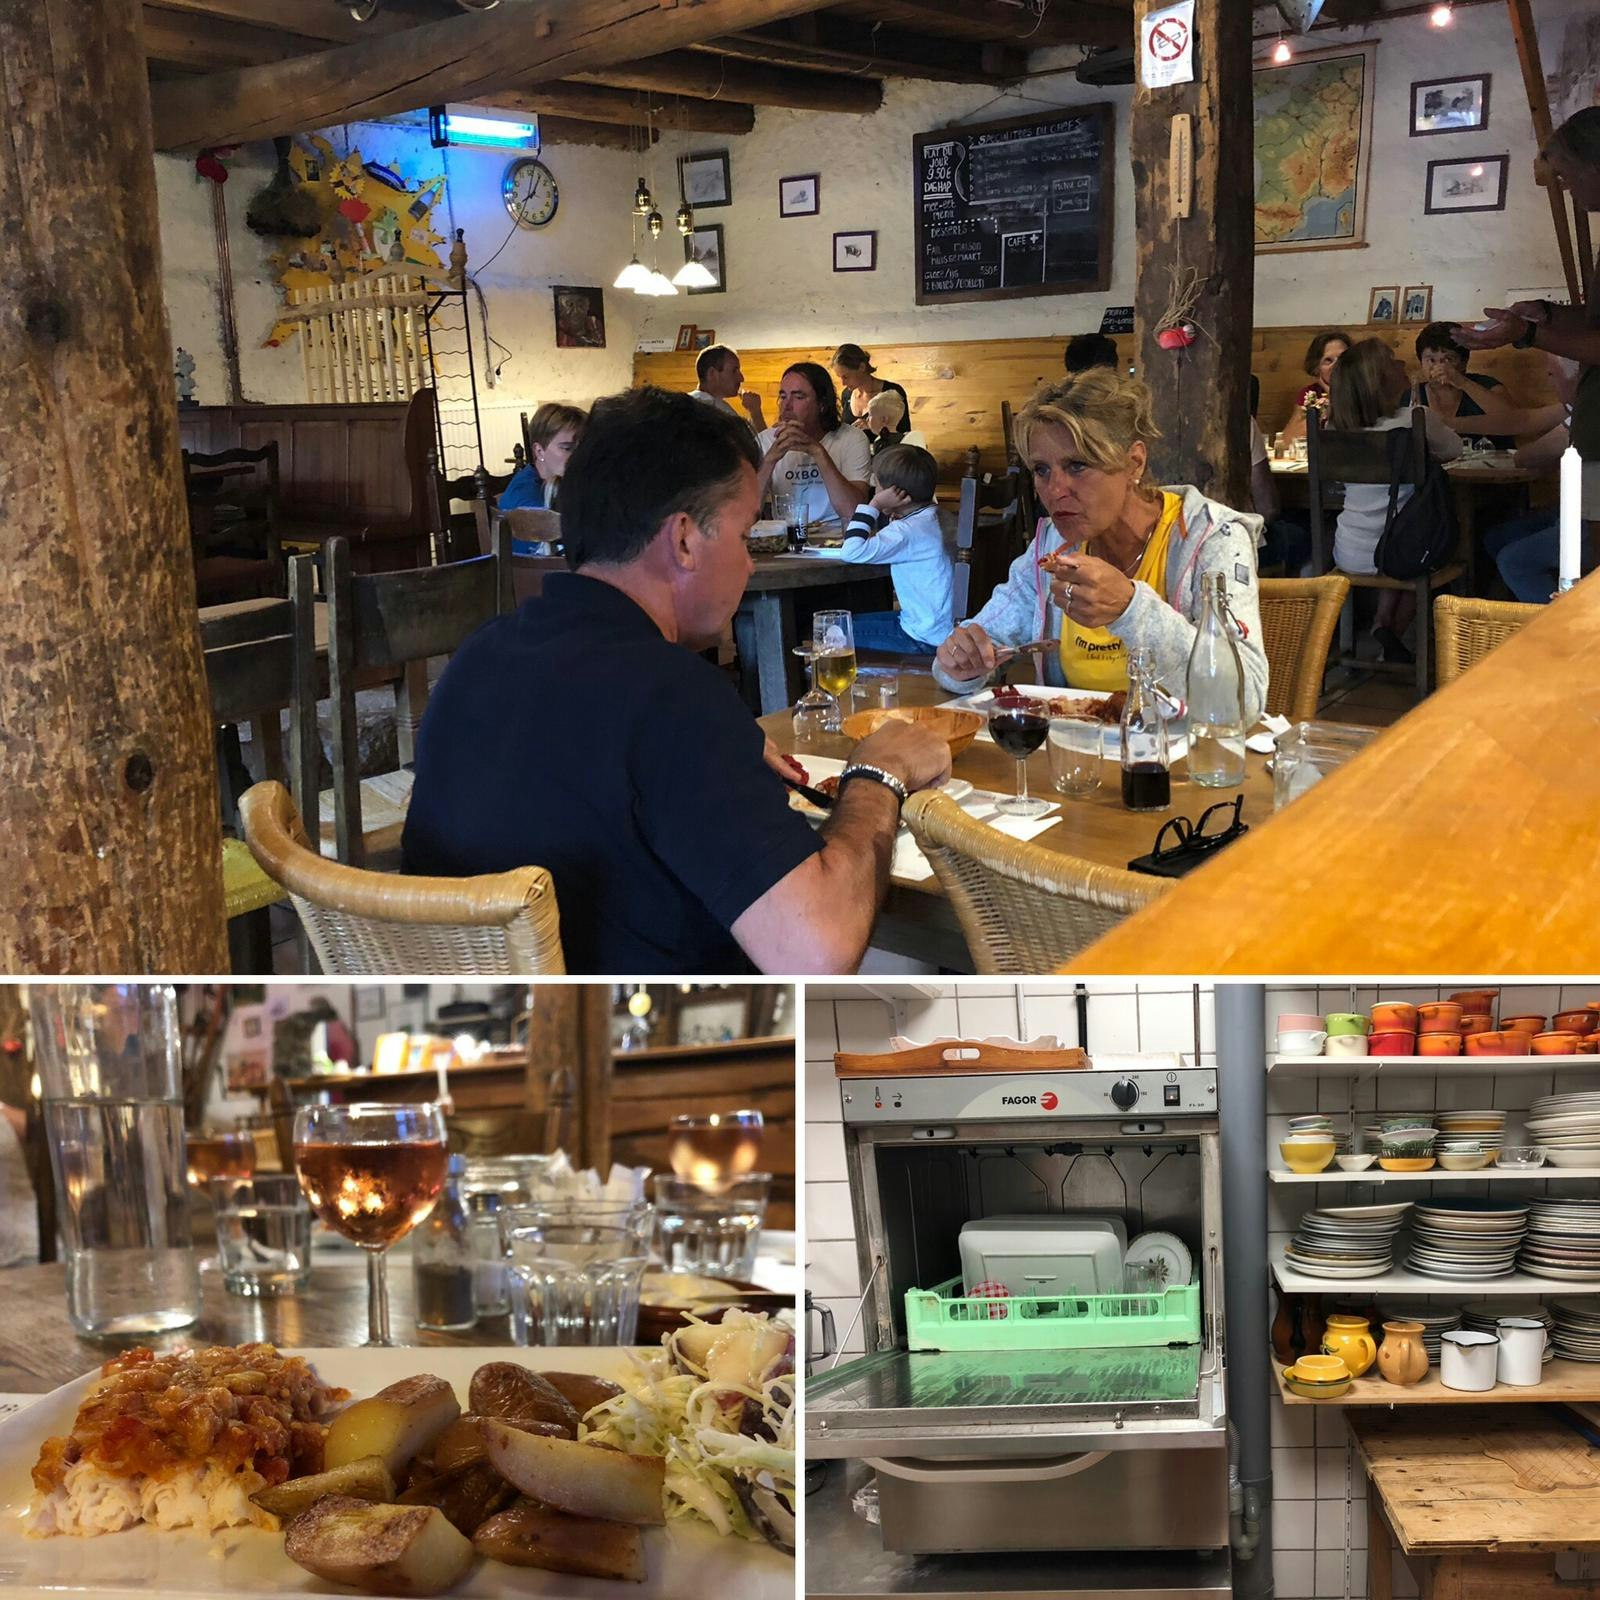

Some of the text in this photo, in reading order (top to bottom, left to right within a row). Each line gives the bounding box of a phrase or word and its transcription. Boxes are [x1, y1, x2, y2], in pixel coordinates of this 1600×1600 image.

[924, 146, 952, 159] PLAT DU
[929, 156, 948, 168] JOUR
[924, 181, 952, 193] DAGHAP
[785, 469, 819, 480] OXBO
[1088, 639, 1122, 652] pretty
[1002, 1096, 1037, 1105] FAGOR
